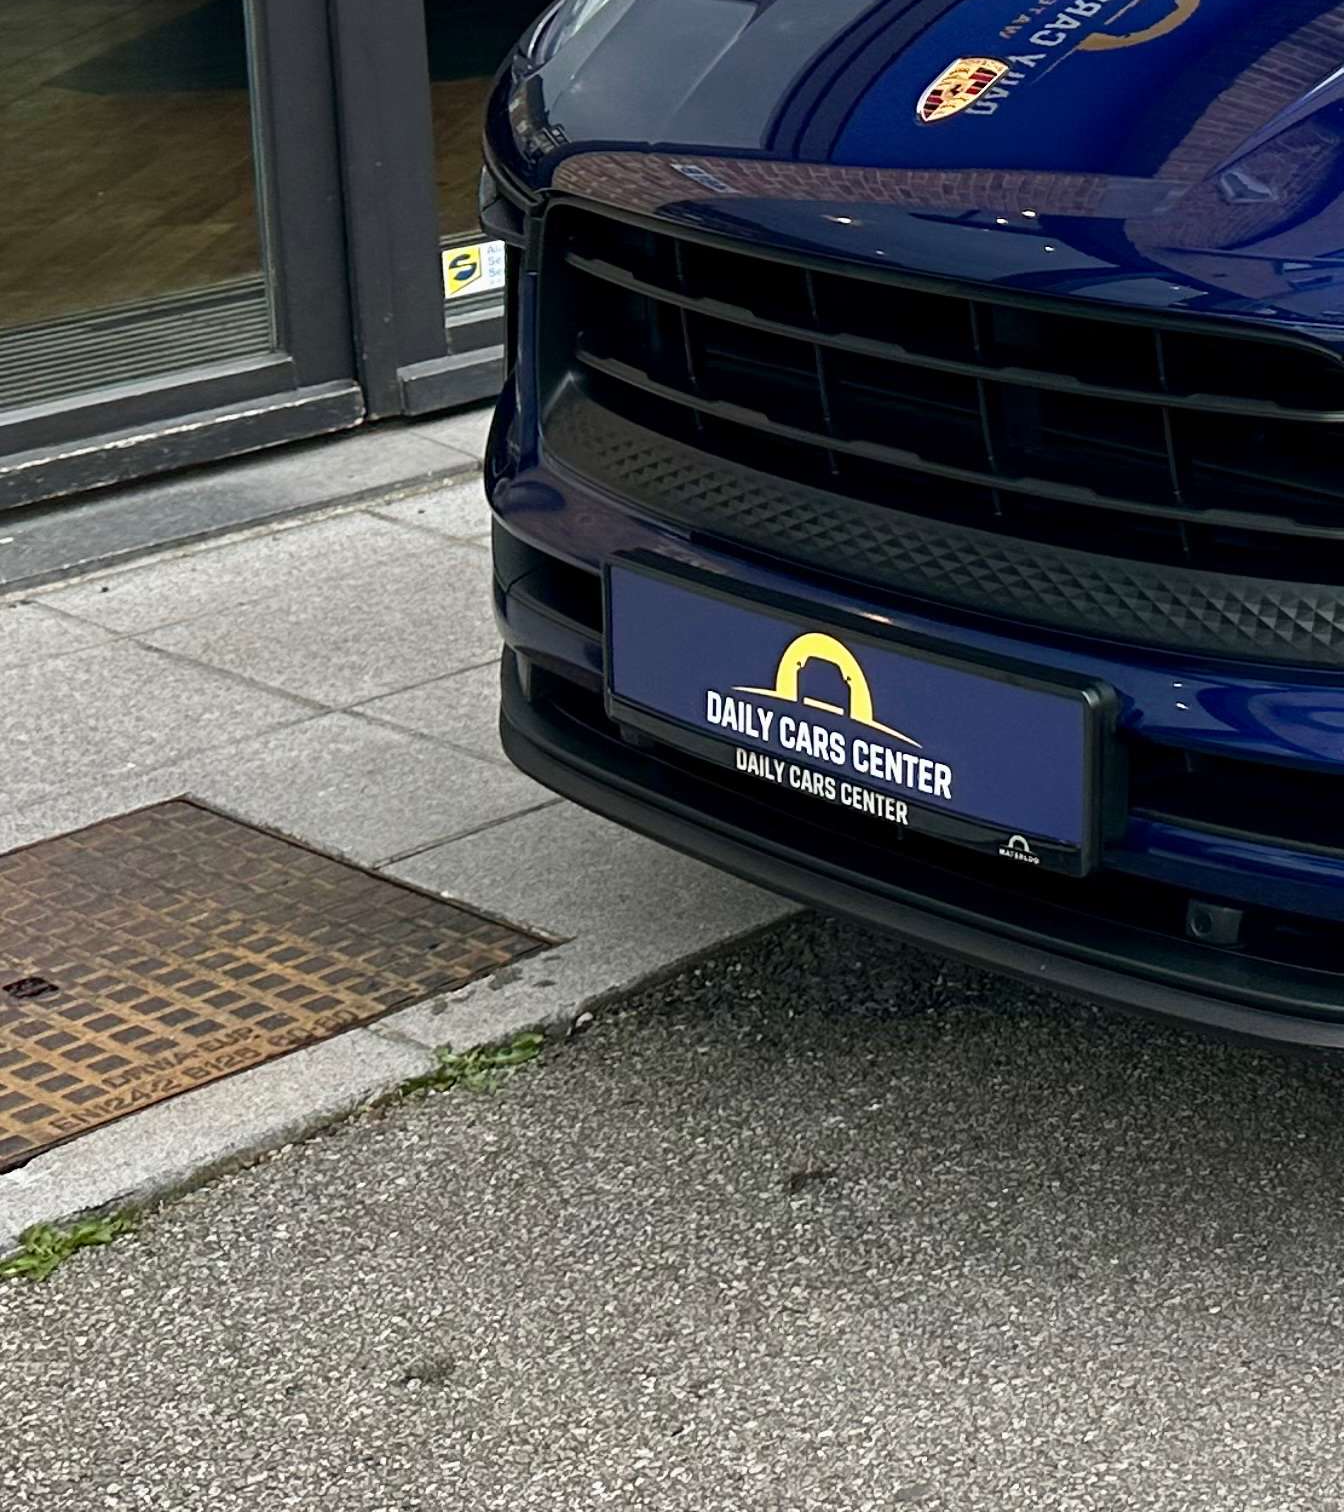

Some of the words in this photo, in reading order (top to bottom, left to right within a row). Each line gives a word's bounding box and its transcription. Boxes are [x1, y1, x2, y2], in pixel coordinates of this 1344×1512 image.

[707, 690, 774, 742] DAILY
[779, 716, 846, 765] CARS
[852, 739, 952, 799] CENTER
[736, 748, 785, 784] DAILY
[789, 765, 836, 800] CARS
[840, 783, 909, 825] CENTER
